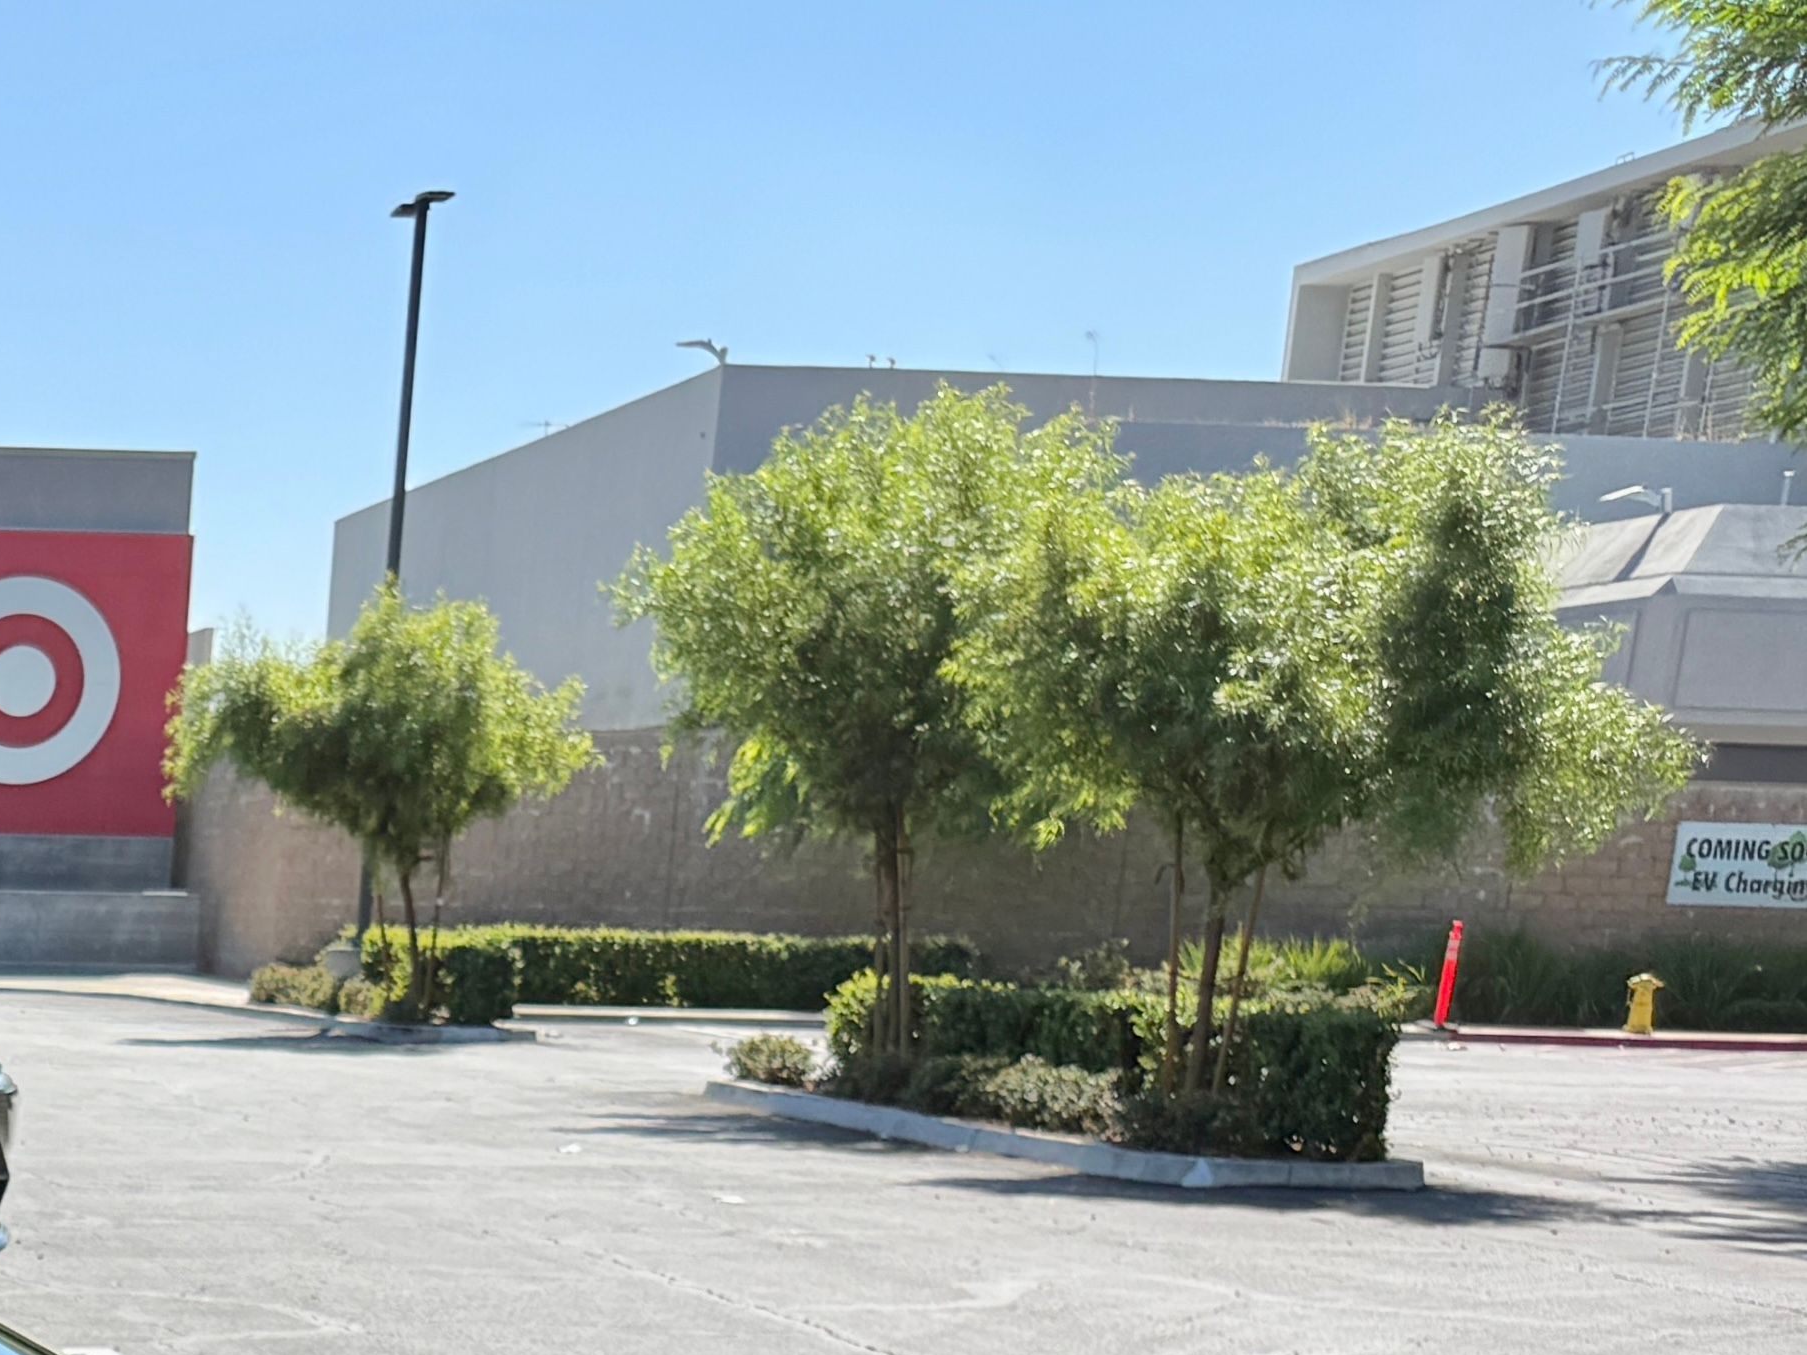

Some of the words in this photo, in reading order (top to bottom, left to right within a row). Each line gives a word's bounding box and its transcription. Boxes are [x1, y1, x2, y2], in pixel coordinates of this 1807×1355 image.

[1686, 837, 1772, 861] COMING
[1776, 840, 1807, 863] SO
[1691, 871, 1718, 892] EV
